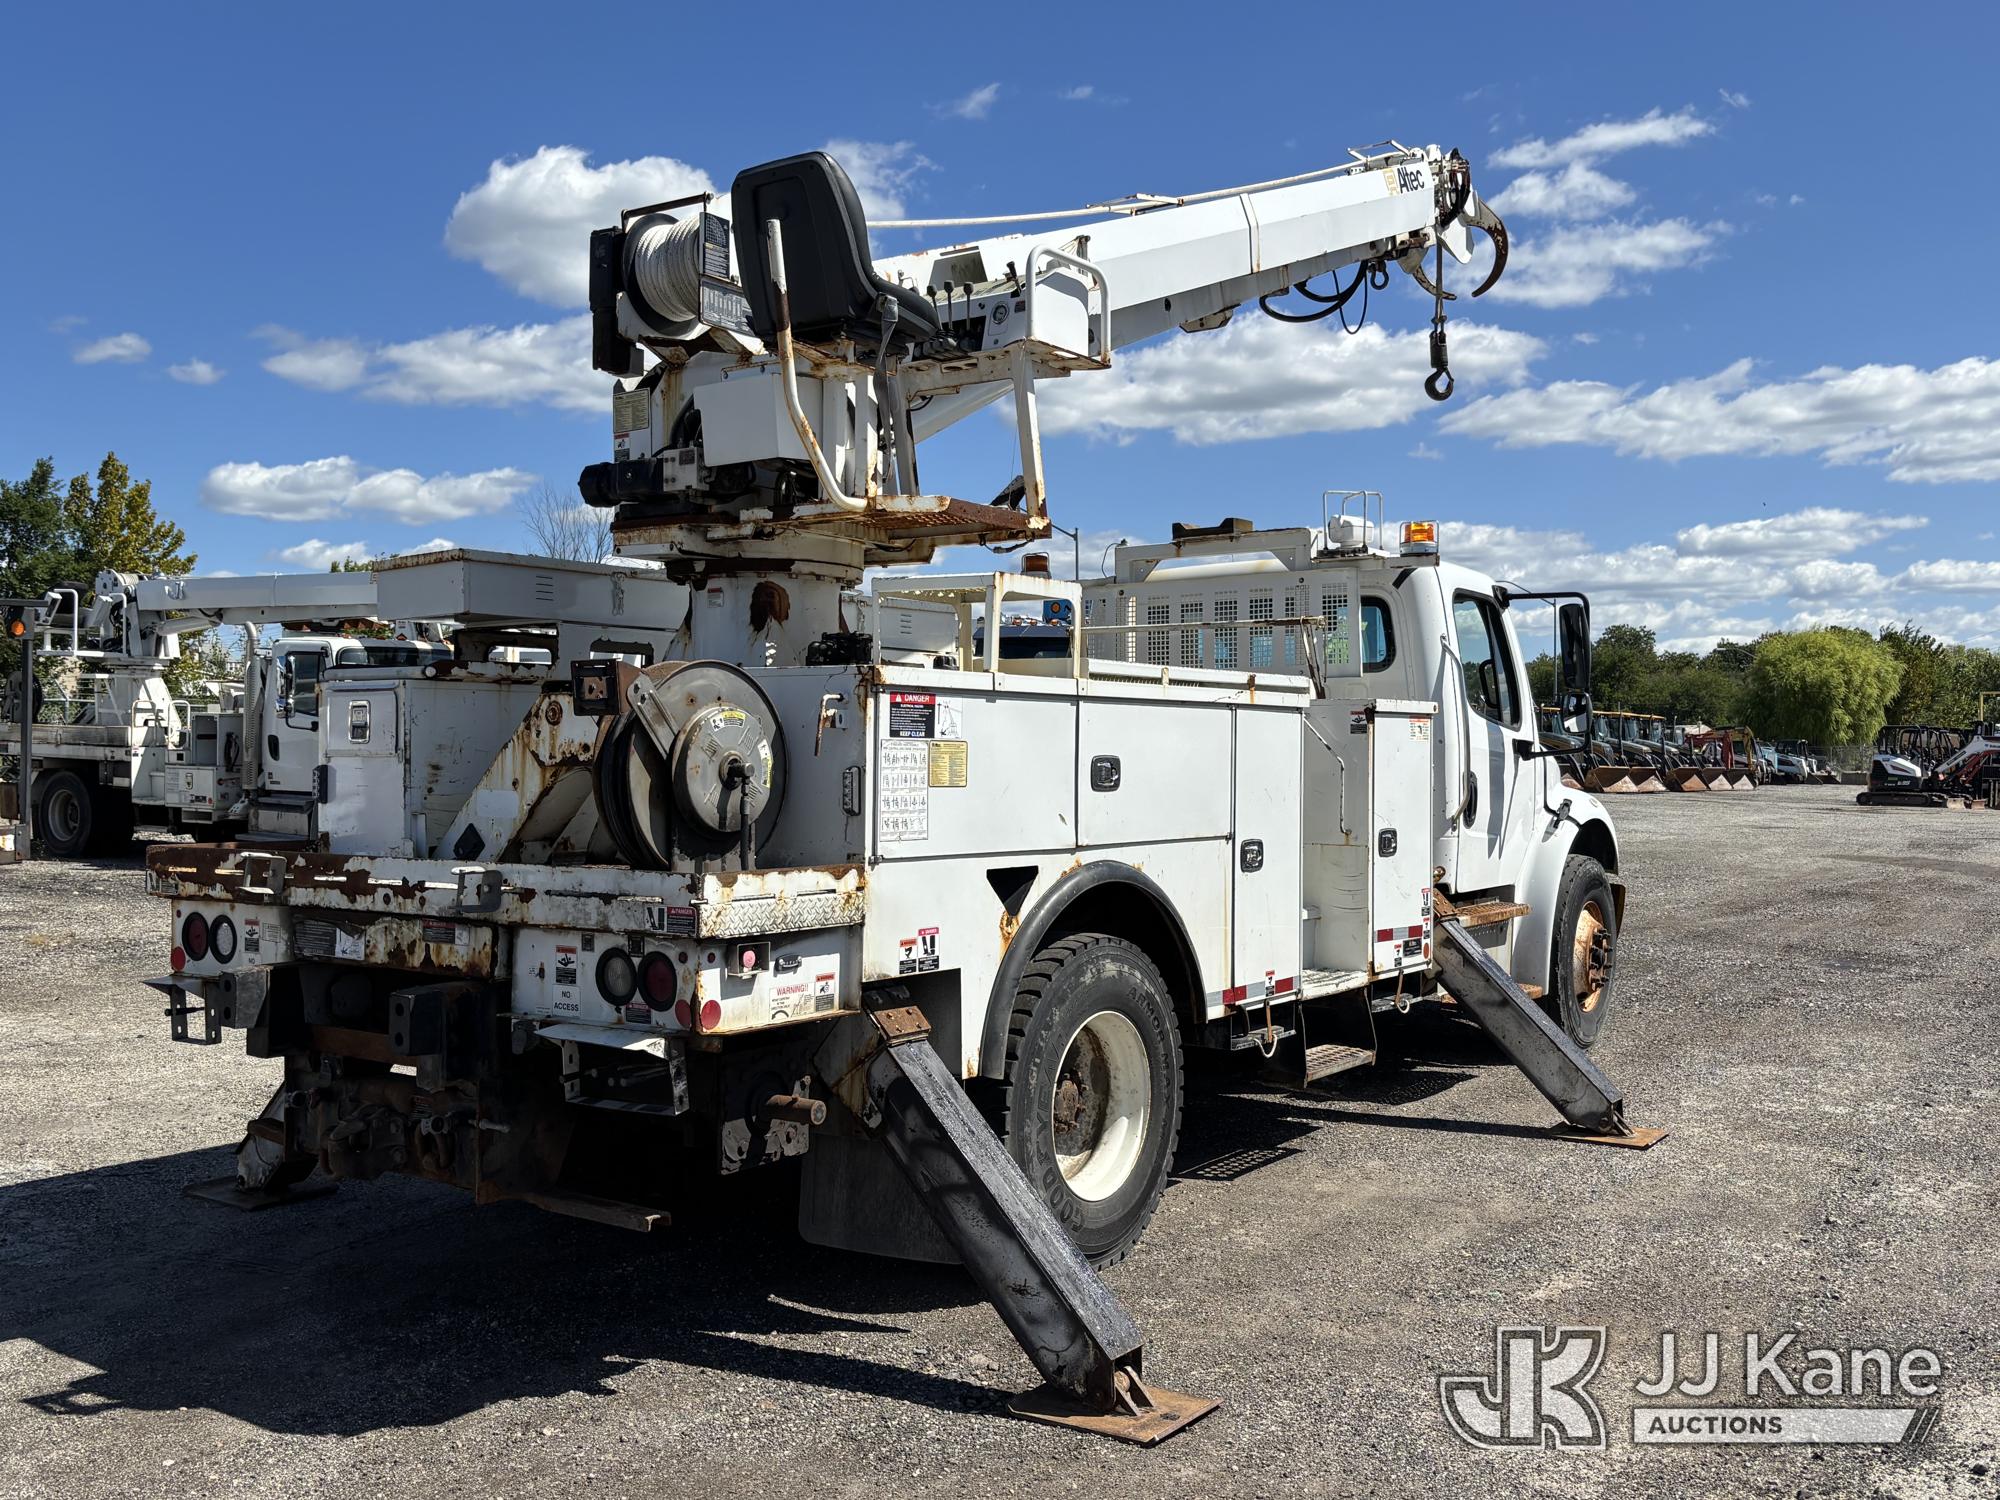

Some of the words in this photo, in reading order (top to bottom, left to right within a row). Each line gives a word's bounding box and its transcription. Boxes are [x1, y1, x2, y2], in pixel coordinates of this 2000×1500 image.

[1396, 166, 1425, 194] Altec
[904, 694, 930, 703] DANGER
[561, 990, 571, 999] NO
[553, 1002, 579, 1012] ACCESS
[1126, 985, 1165, 1043] ARMOR
